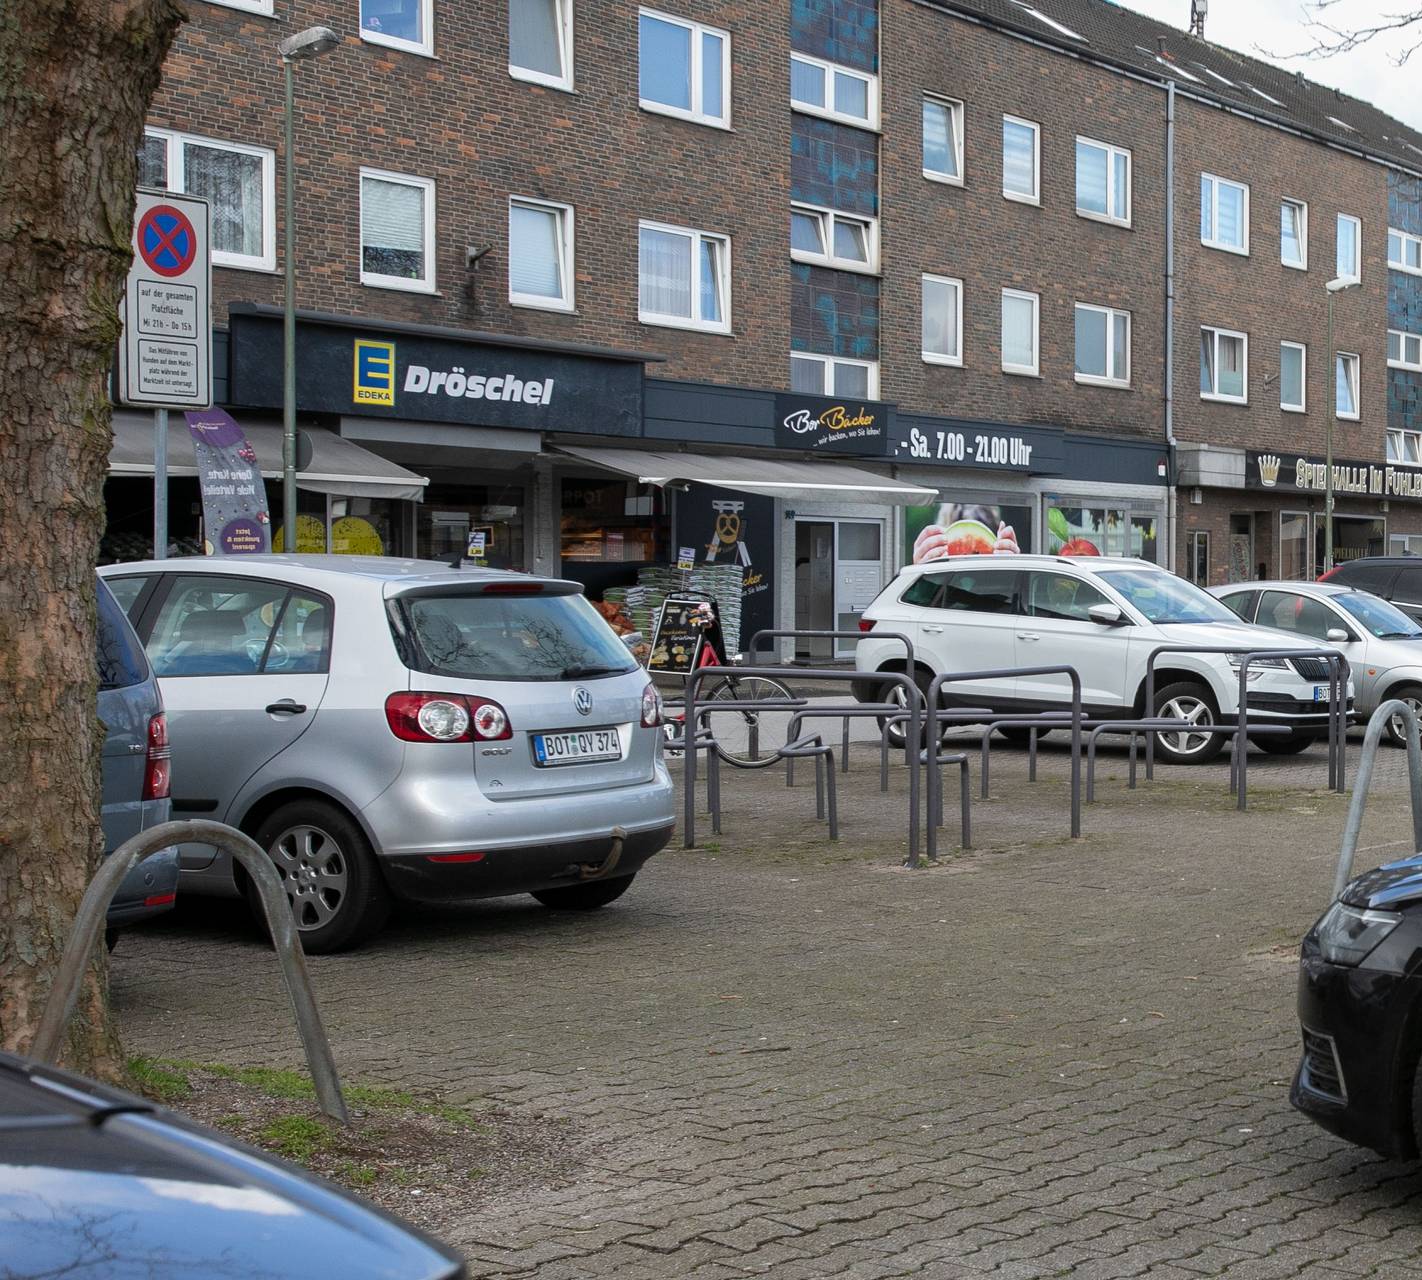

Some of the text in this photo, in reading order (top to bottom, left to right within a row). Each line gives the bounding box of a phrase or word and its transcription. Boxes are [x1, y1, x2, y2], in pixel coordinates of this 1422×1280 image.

[141, 288, 193, 301] auf der gesamten
[151, 303, 184, 315] Platzfläche
[143, 318, 150, 327] Mi
[171, 321, 179, 329] Do
[403, 365, 554, 405] Dröschel
[358, 390, 391, 401] EDEKA
[783, 405, 874, 434] Bor Bäcker
[910, 427, 931, 458] Sa.
[936, 431, 965, 461] 7.00
[975, 435, 1007, 465] 21.00
[1009, 437, 1033, 466] Uhr
[545, 732, 618, 757] BOT QY 374
